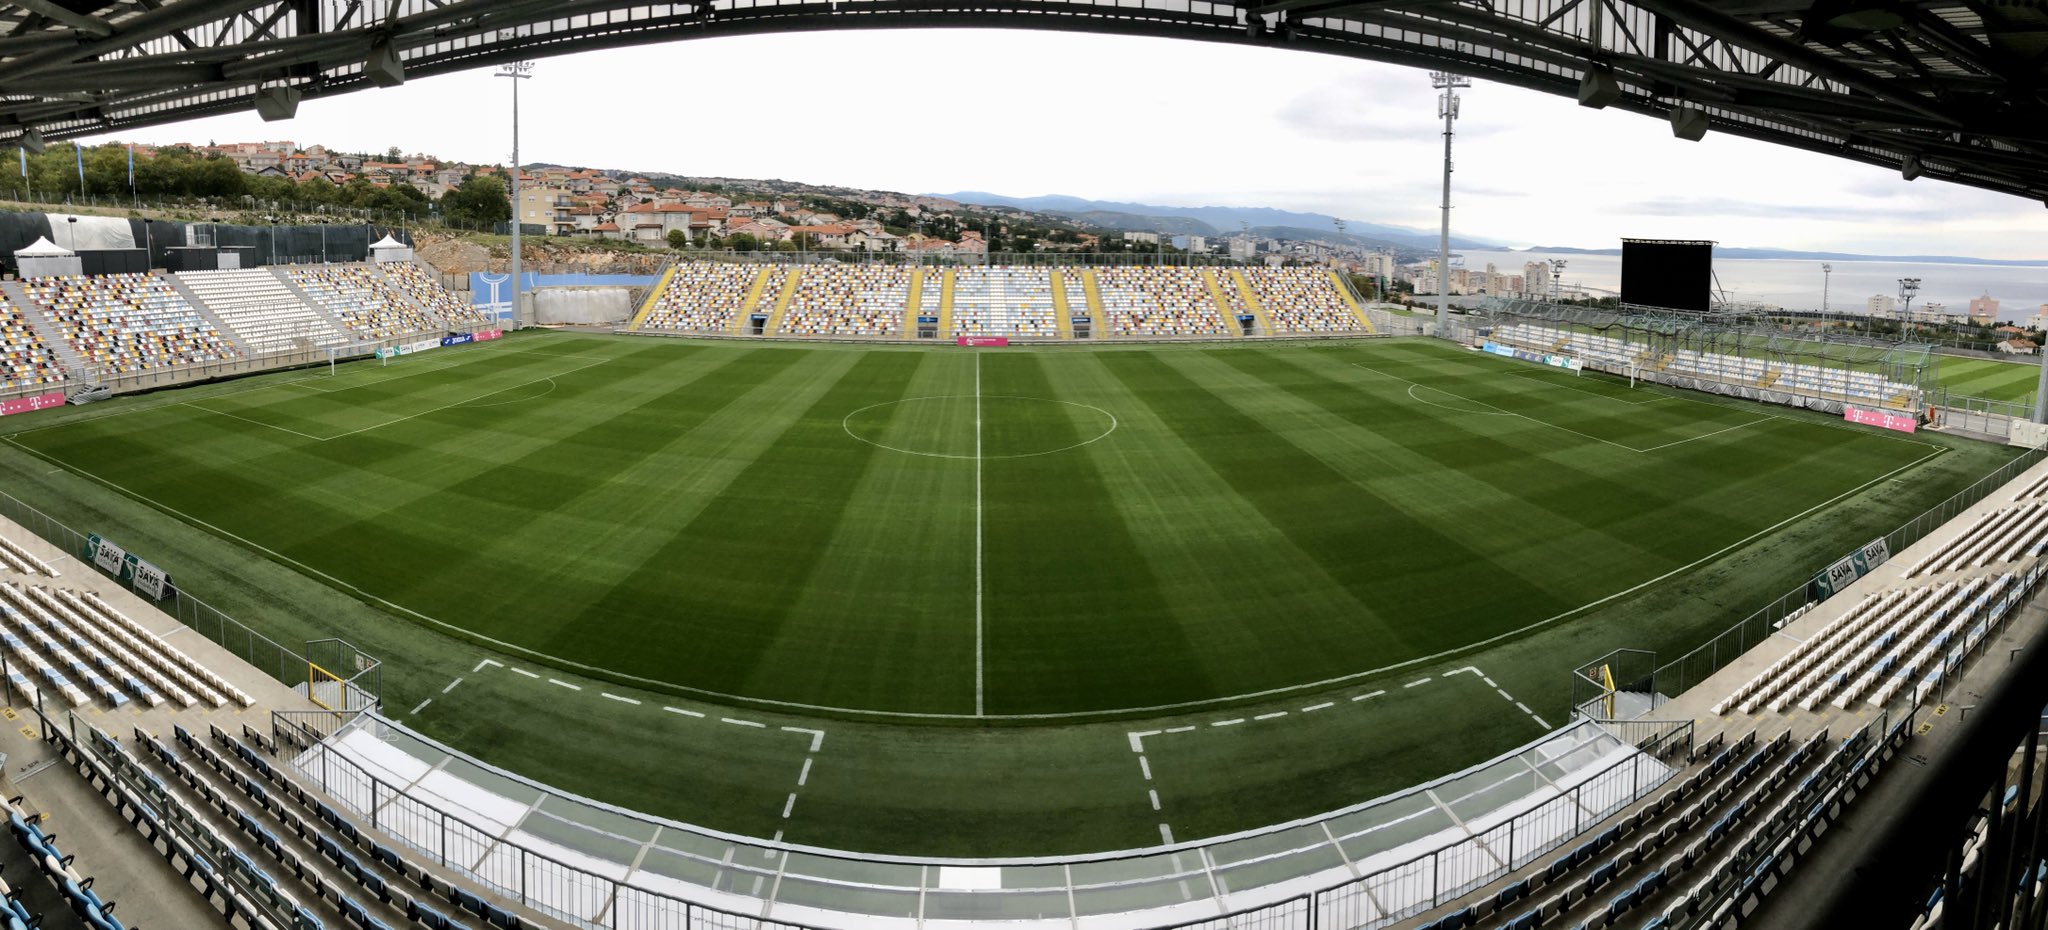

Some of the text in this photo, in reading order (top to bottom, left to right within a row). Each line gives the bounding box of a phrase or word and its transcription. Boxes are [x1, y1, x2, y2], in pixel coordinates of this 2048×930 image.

[100, 545, 119, 566] SAVA
[139, 566, 160, 589] SAVA
[1831, 562, 1852, 582] SAVA
[1865, 543, 1885, 561] SAVA
